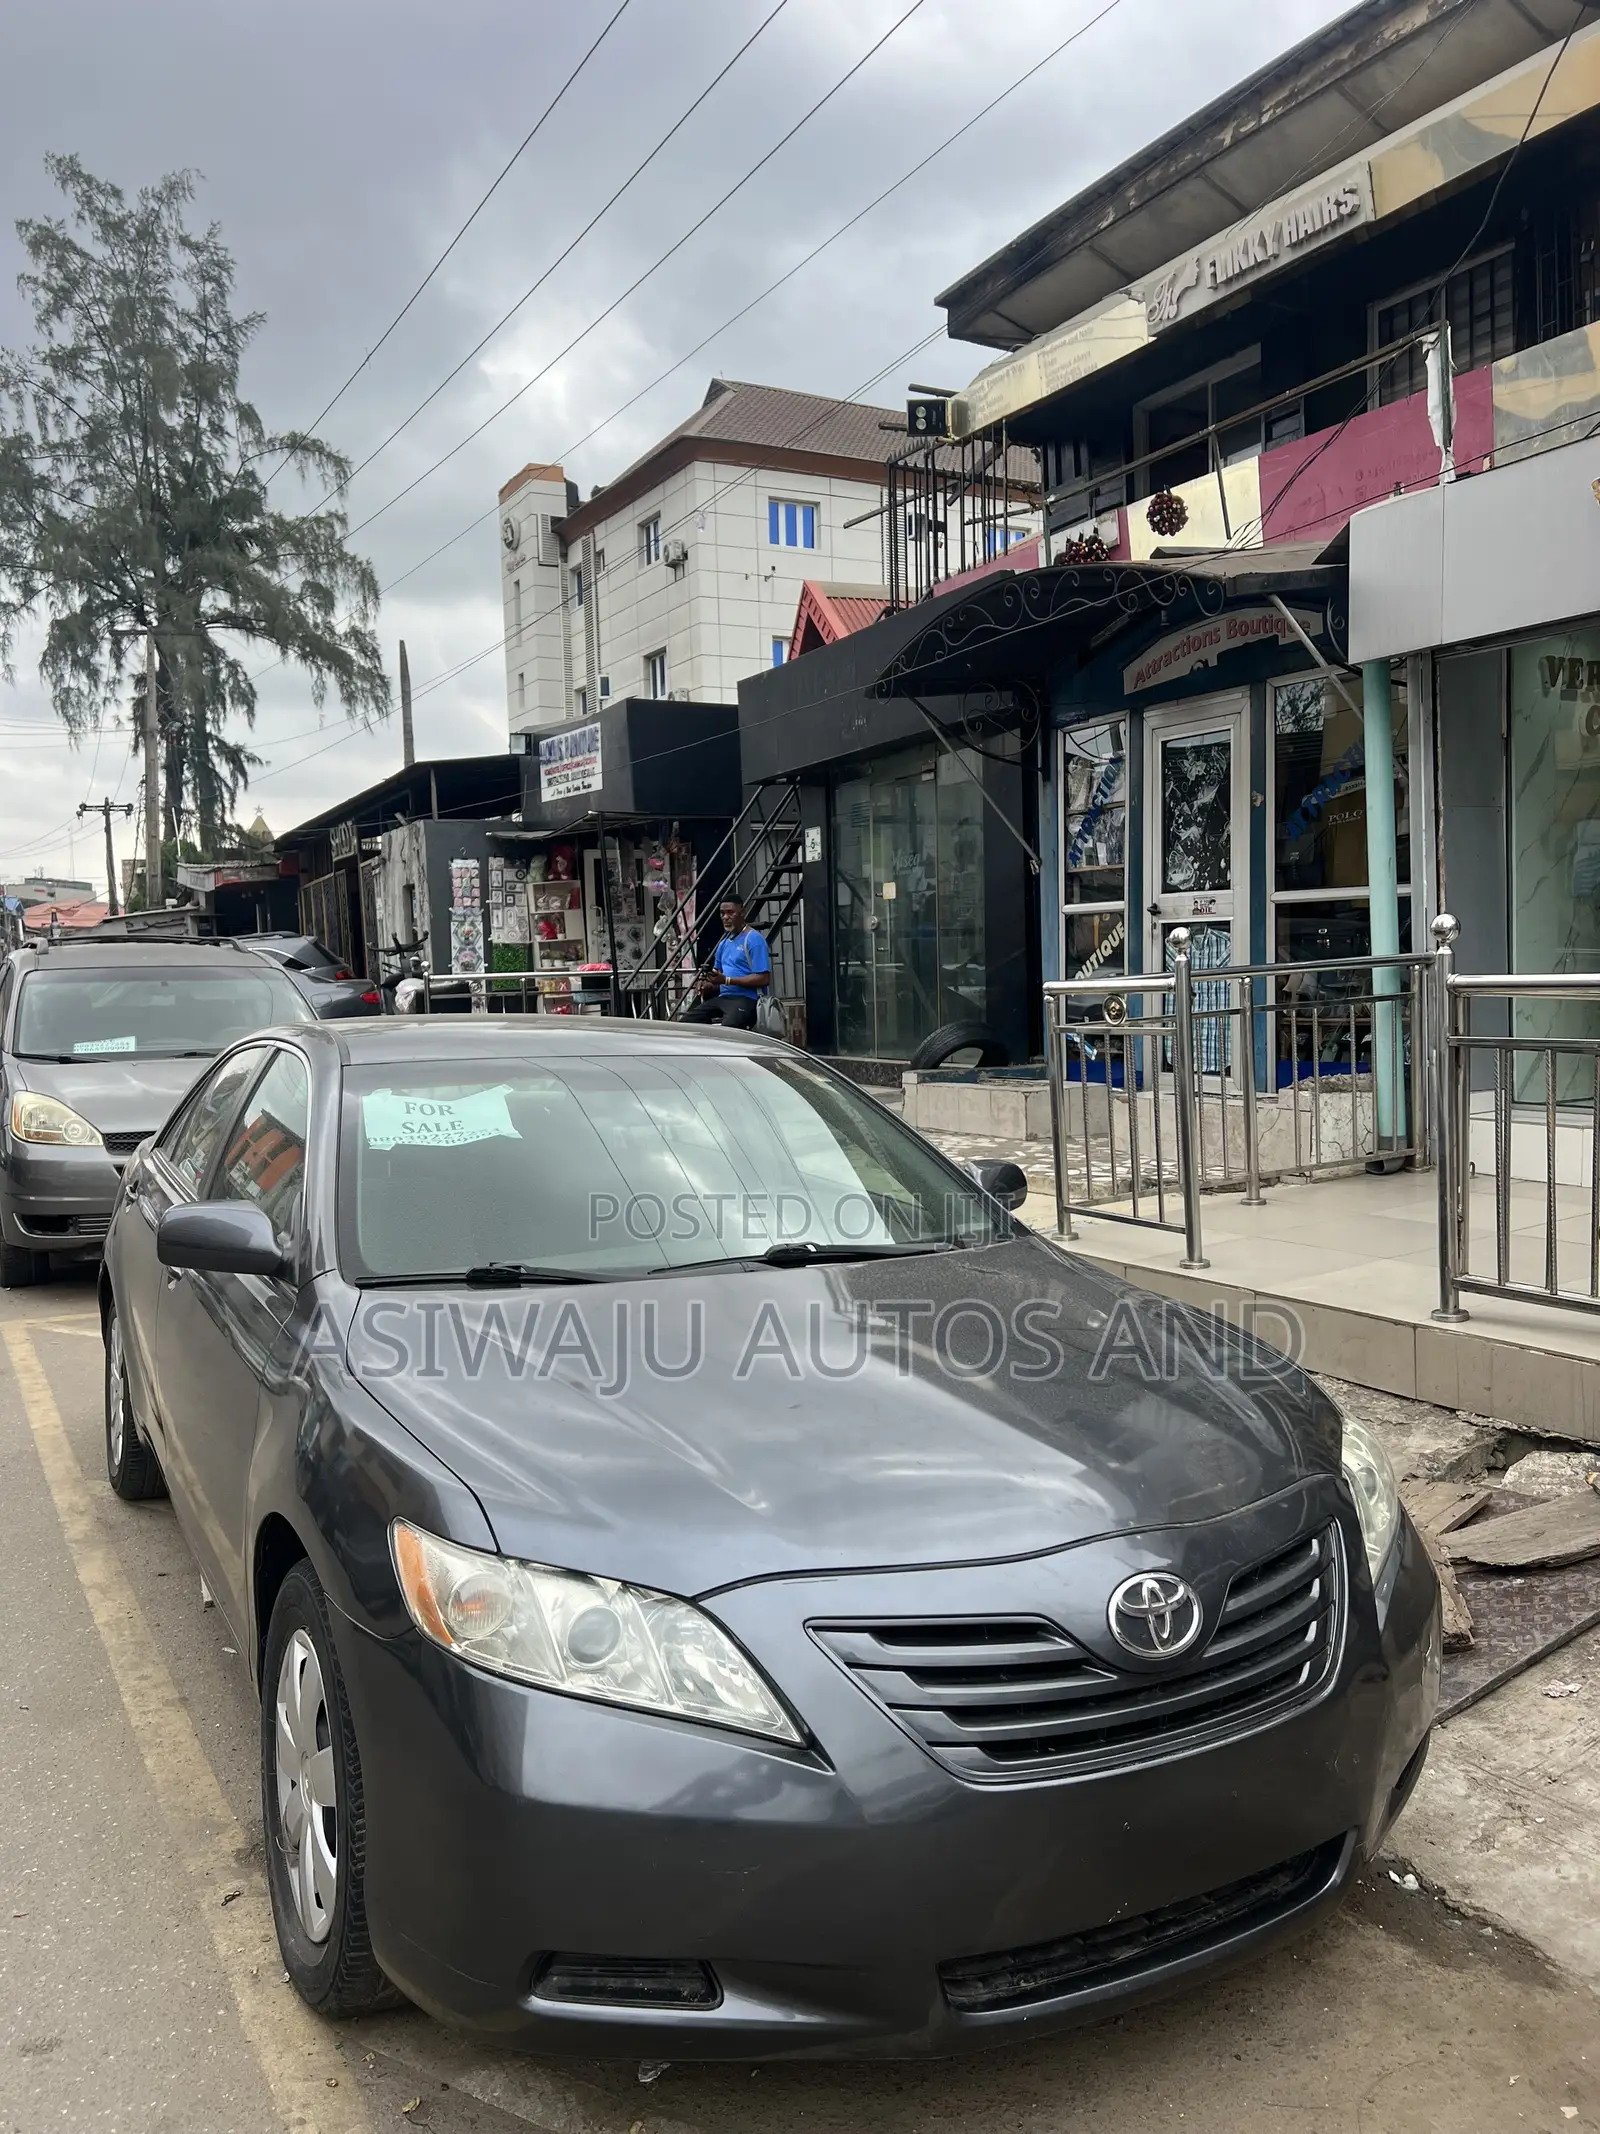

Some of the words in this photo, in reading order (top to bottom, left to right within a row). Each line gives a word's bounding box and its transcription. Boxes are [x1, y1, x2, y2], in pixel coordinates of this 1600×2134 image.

[1282, 181, 1361, 249] HAIRS
[1133, 627, 1221, 690] Attractions
[402, 1120, 464, 1135] SALE
[404, 1101, 455, 1116] FOR
